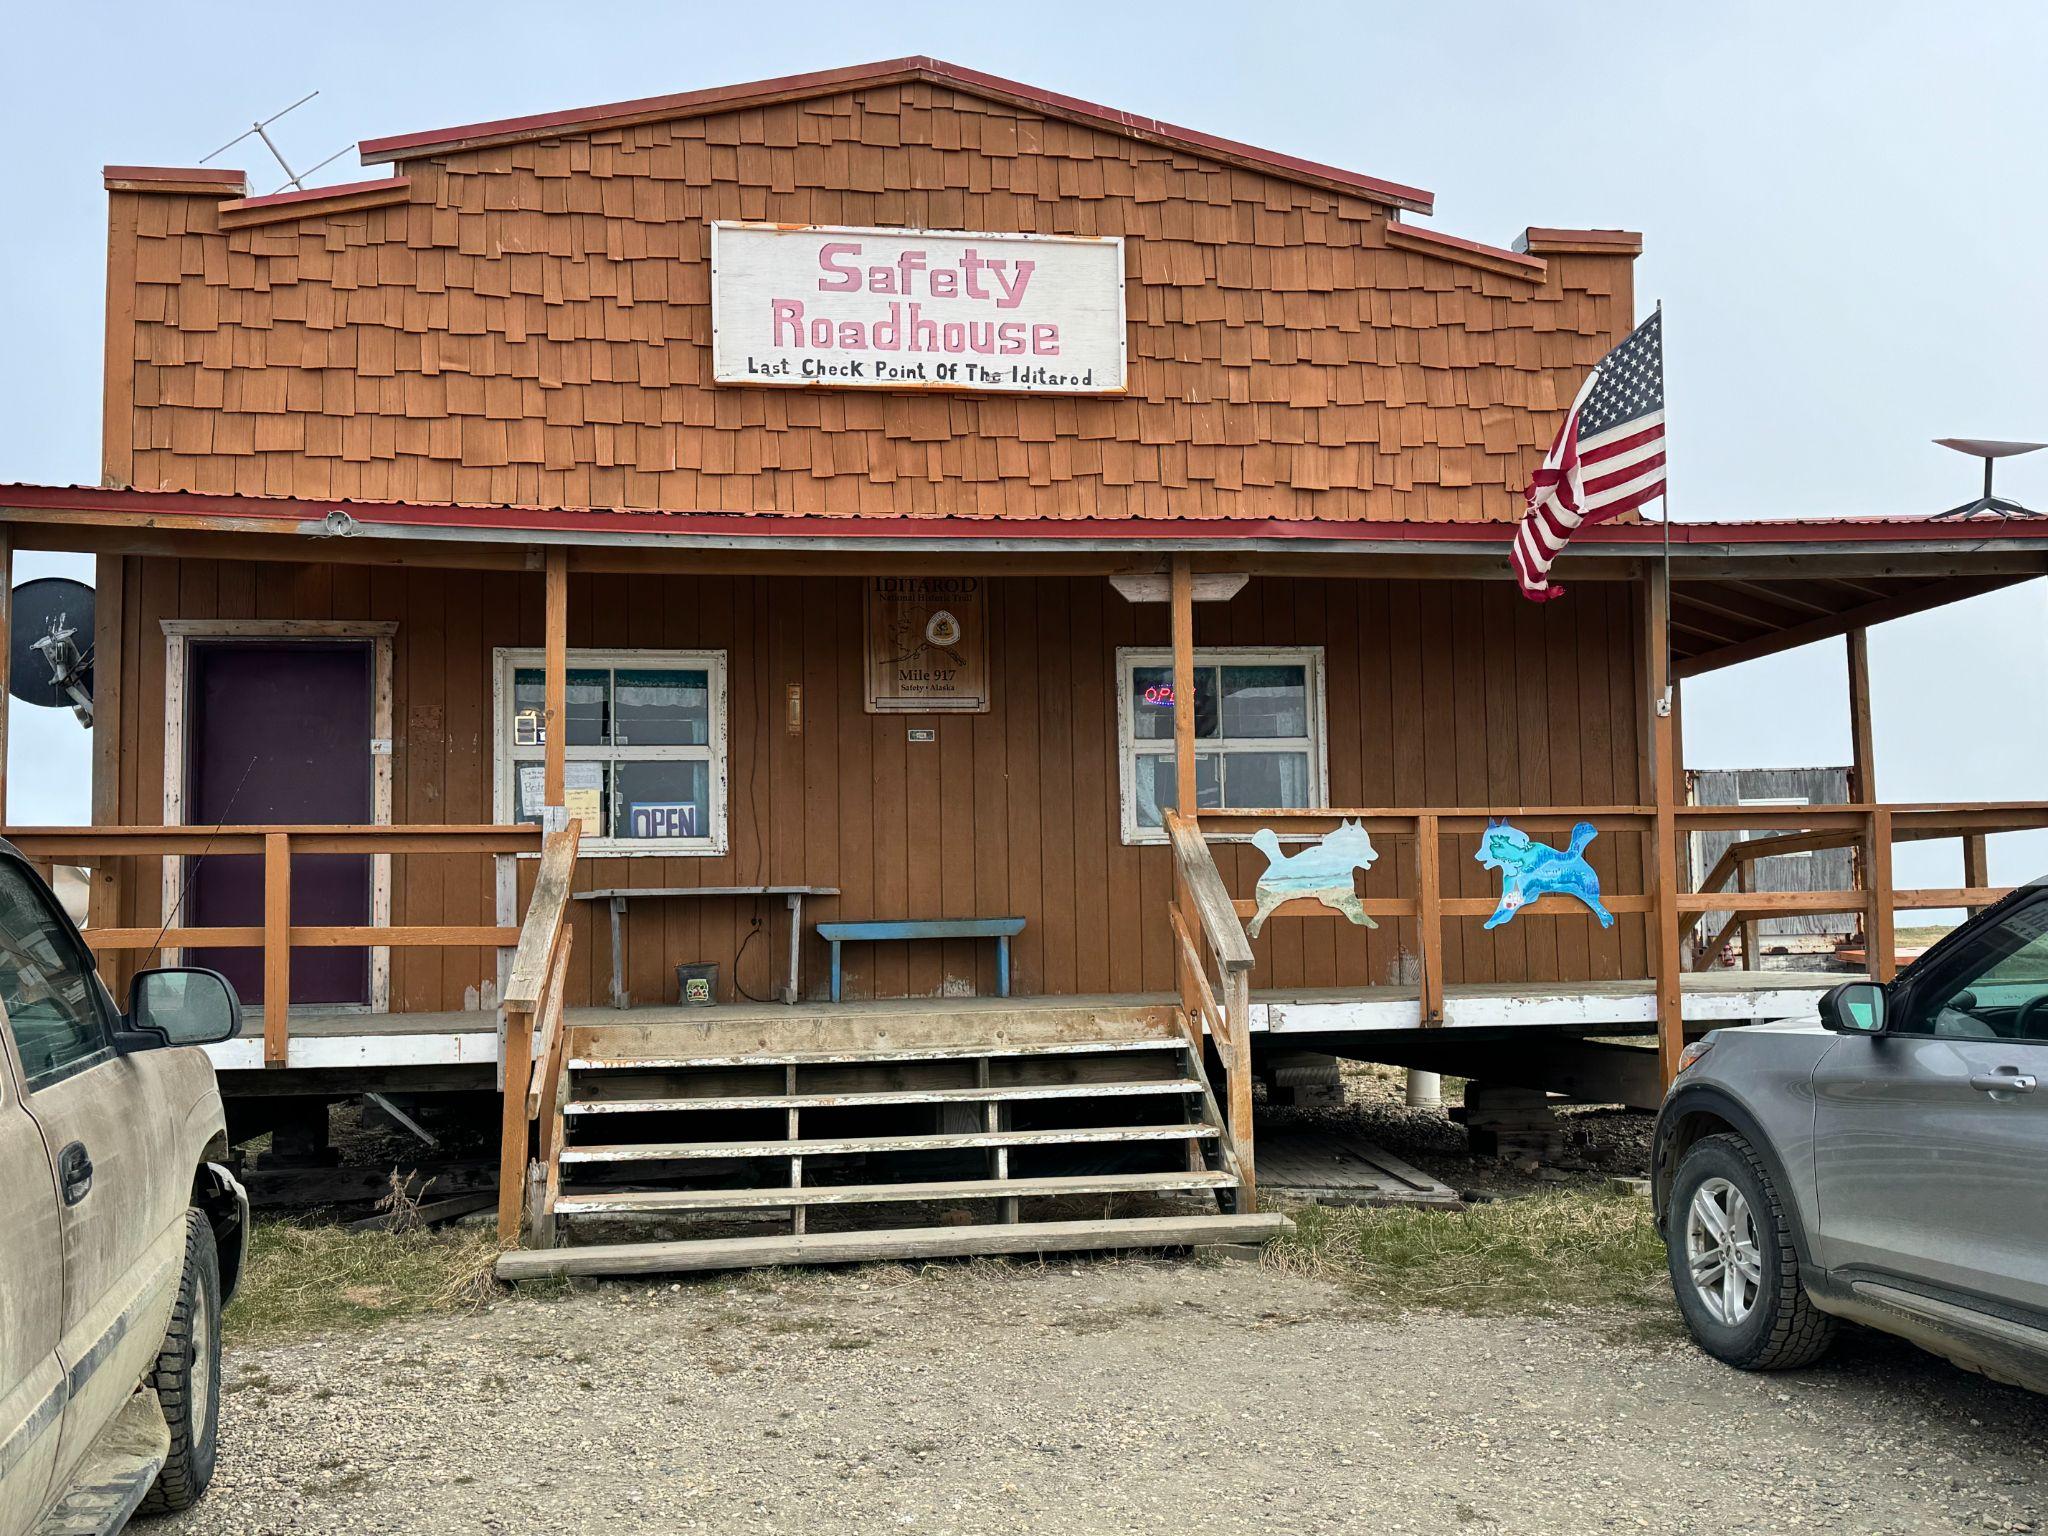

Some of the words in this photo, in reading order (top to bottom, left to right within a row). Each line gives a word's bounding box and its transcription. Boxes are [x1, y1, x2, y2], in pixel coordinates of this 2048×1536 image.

[818, 242, 1036, 308] Safety
[771, 299, 1060, 355] Roadhouse
[748, 356, 790, 377] Last
[875, 360, 927, 381] Point
[936, 363, 958, 381] Of
[965, 363, 1002, 383] The
[1011, 365, 1092, 386] Iditarod
[899, 669, 930, 681] Mile
[934, 669, 957, 681] 917
[901, 684, 925, 693] Safety
[929, 684, 955, 692] Alaska
[633, 808, 695, 837] OPEN
